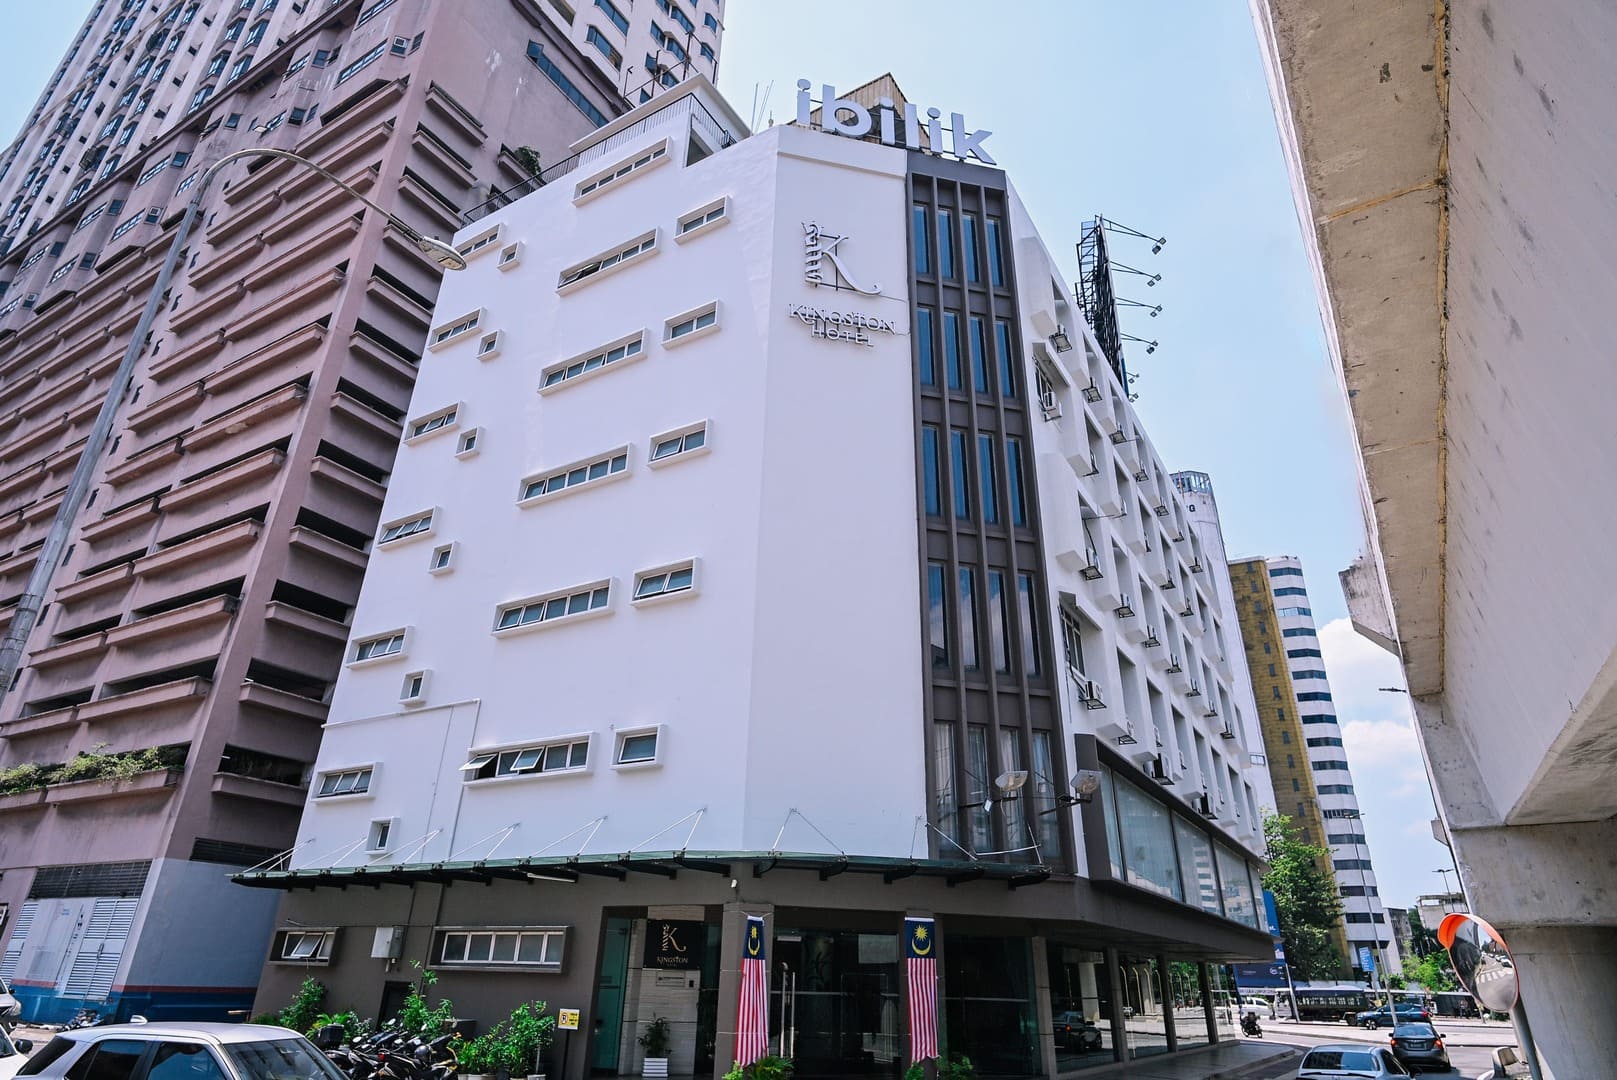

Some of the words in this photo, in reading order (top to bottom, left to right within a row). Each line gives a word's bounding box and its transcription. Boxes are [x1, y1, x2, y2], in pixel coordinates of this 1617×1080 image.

[796, 78, 997, 165] ibilik
[788, 303, 896, 335] KINGSTON
[811, 327, 874, 347] HOTEL
[656, 956, 689, 965] KINGSTON
